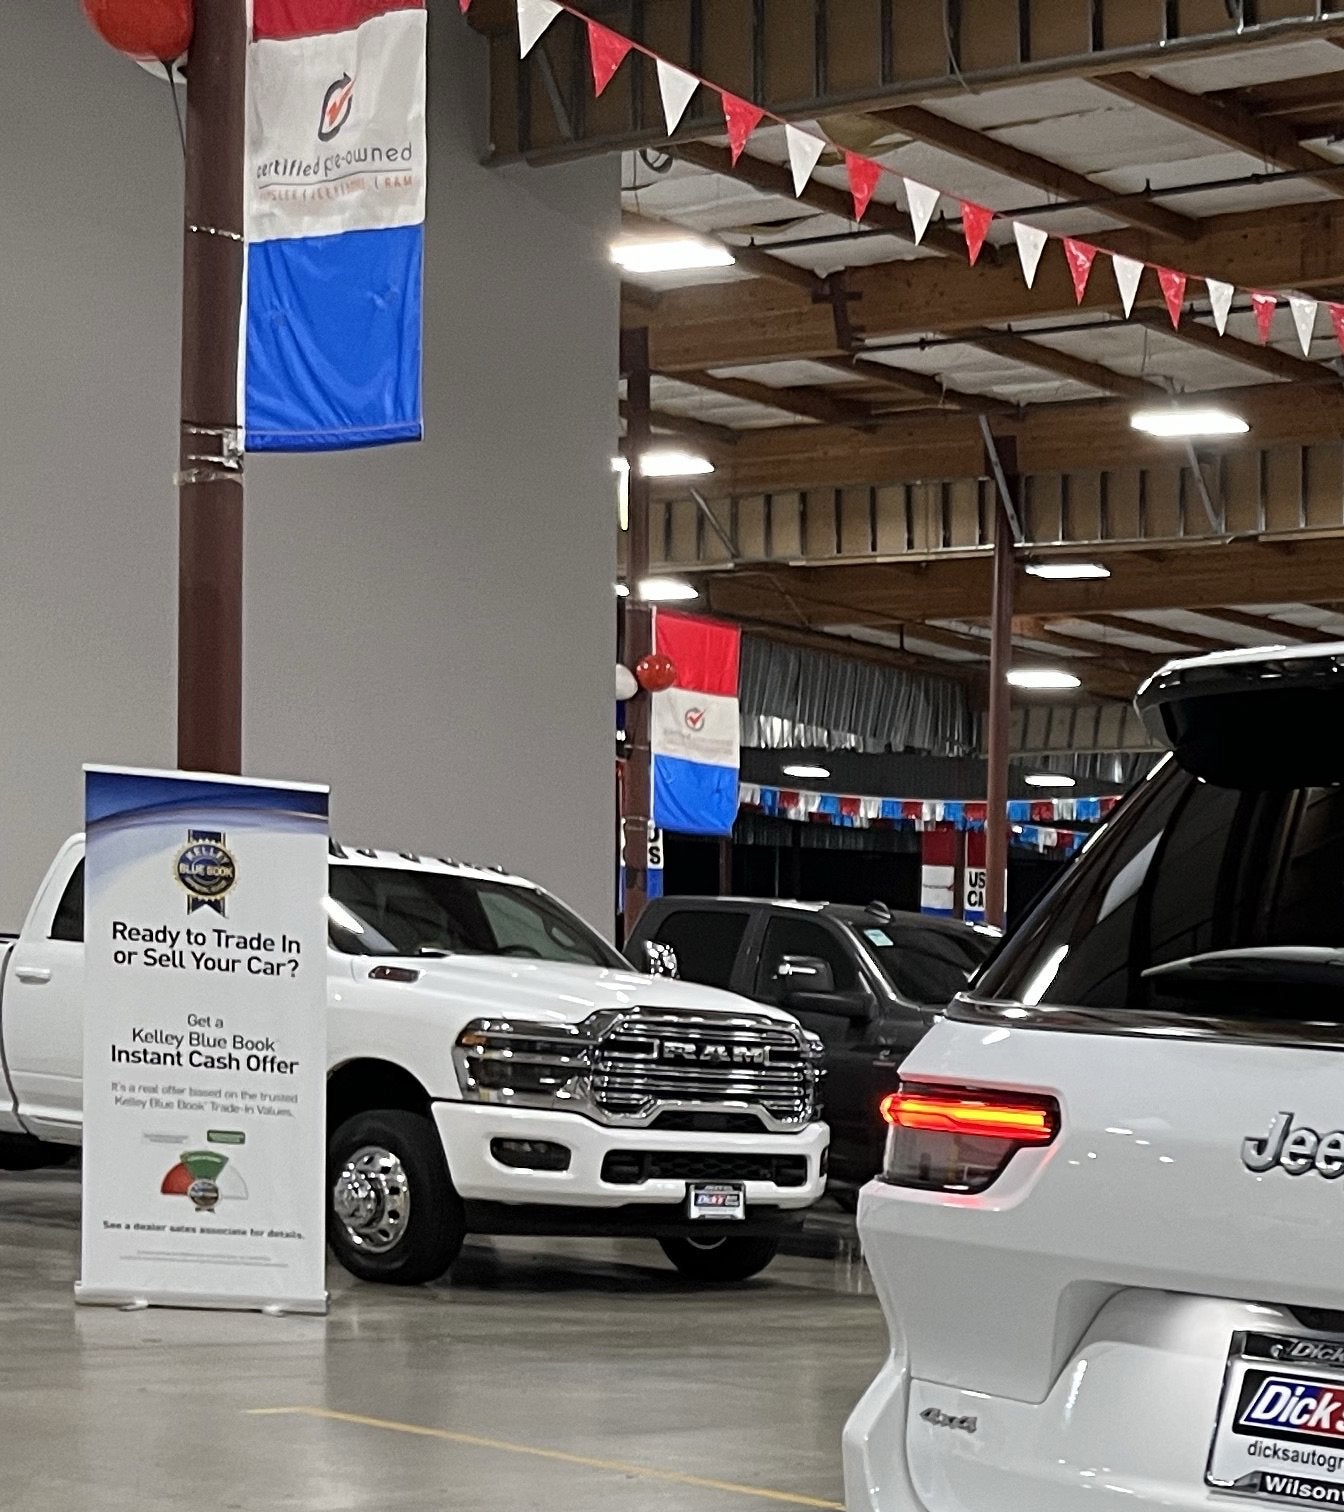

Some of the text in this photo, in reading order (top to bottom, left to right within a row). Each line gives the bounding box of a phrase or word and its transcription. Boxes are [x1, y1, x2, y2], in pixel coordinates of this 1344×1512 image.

[112, 921, 301, 954] Ready to Trade In
[113, 947, 300, 978] or Sell Your Car?
[187, 1013, 224, 1029] Get a
[132, 1028, 276, 1052] Kelley Blue Book
[663, 1041, 764, 1063] RAM
[111, 1044, 300, 1075] Instant Cash Offer
